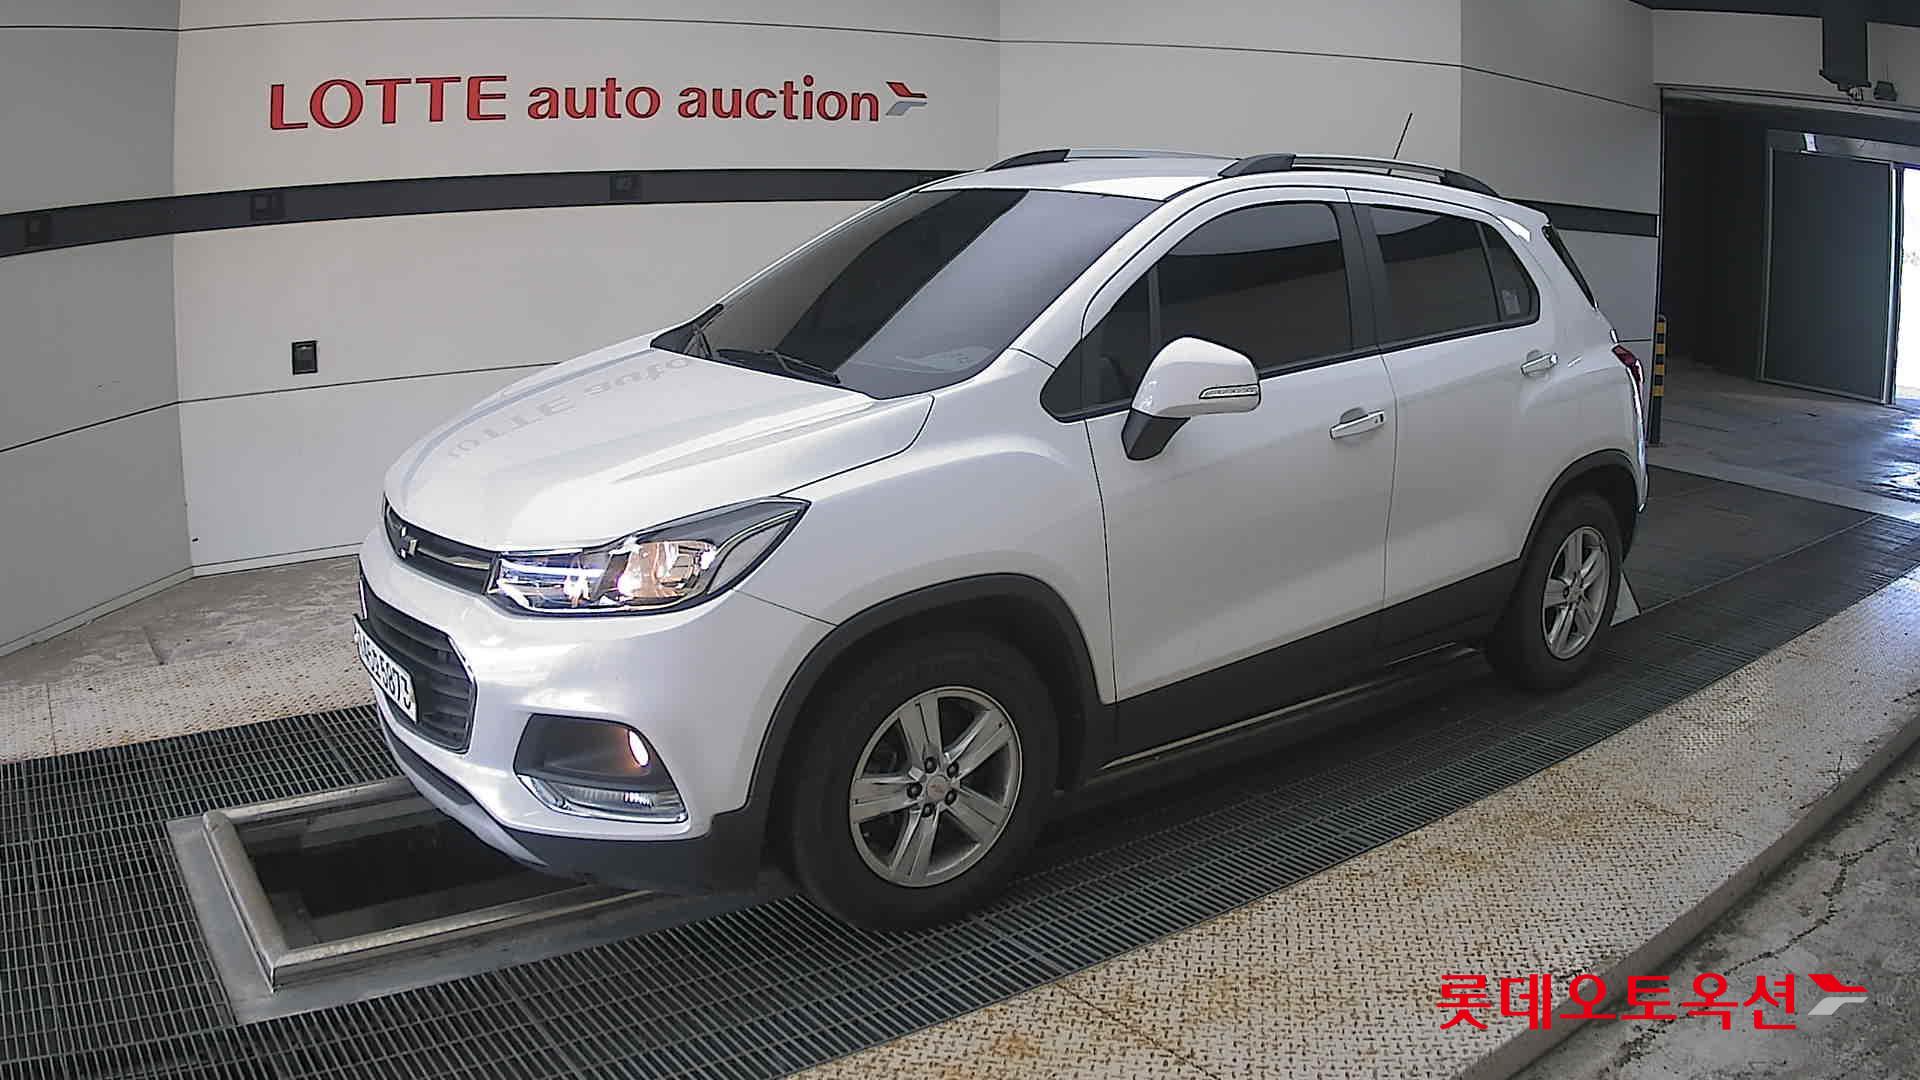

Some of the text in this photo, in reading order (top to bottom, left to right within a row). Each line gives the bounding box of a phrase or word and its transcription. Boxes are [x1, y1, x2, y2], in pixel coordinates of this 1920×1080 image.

[269, 74, 880, 130] LOTTE auto auction
